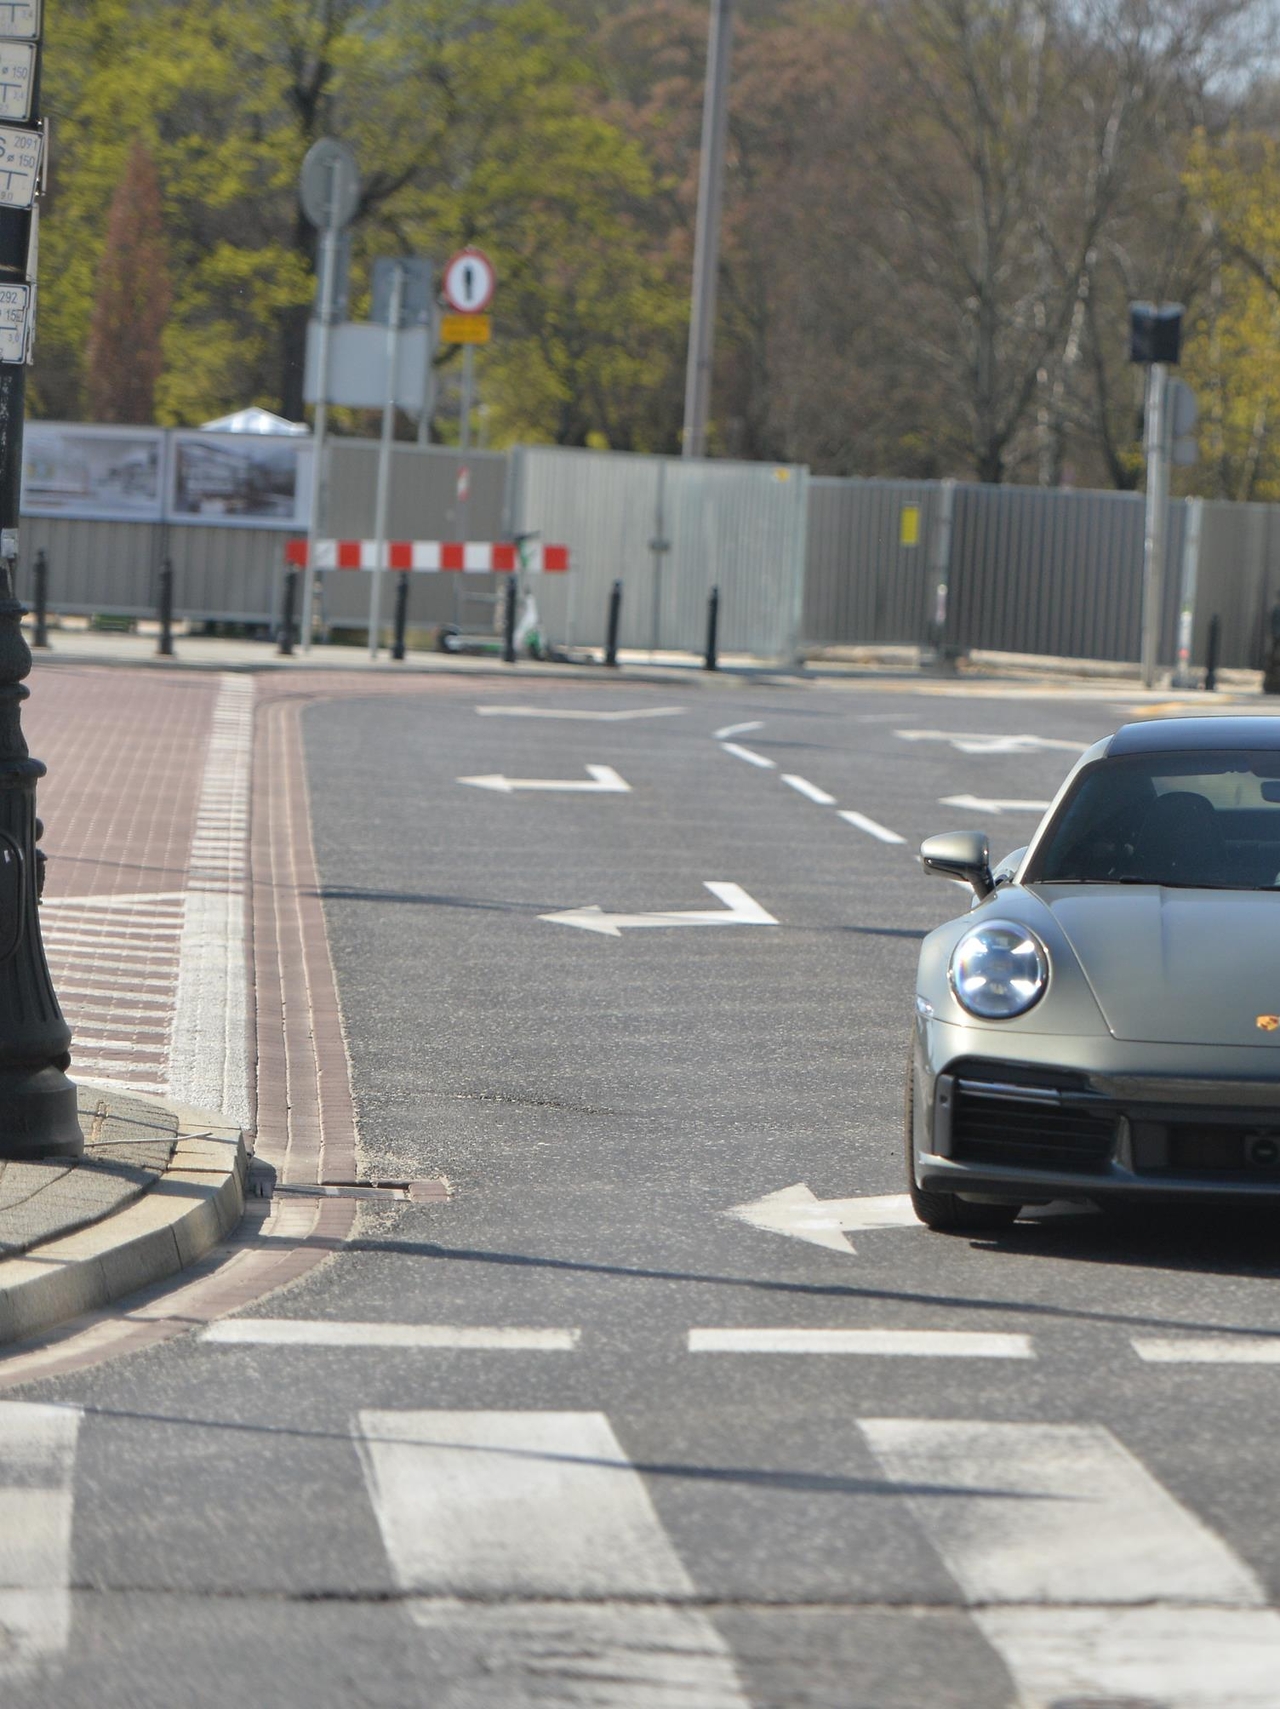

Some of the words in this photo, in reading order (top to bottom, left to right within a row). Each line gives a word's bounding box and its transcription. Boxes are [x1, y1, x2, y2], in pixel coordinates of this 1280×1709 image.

[13, 66, 27, 79] 150
[14, 136, 38, 150] 2091
[19, 153, 35, 168] 150
